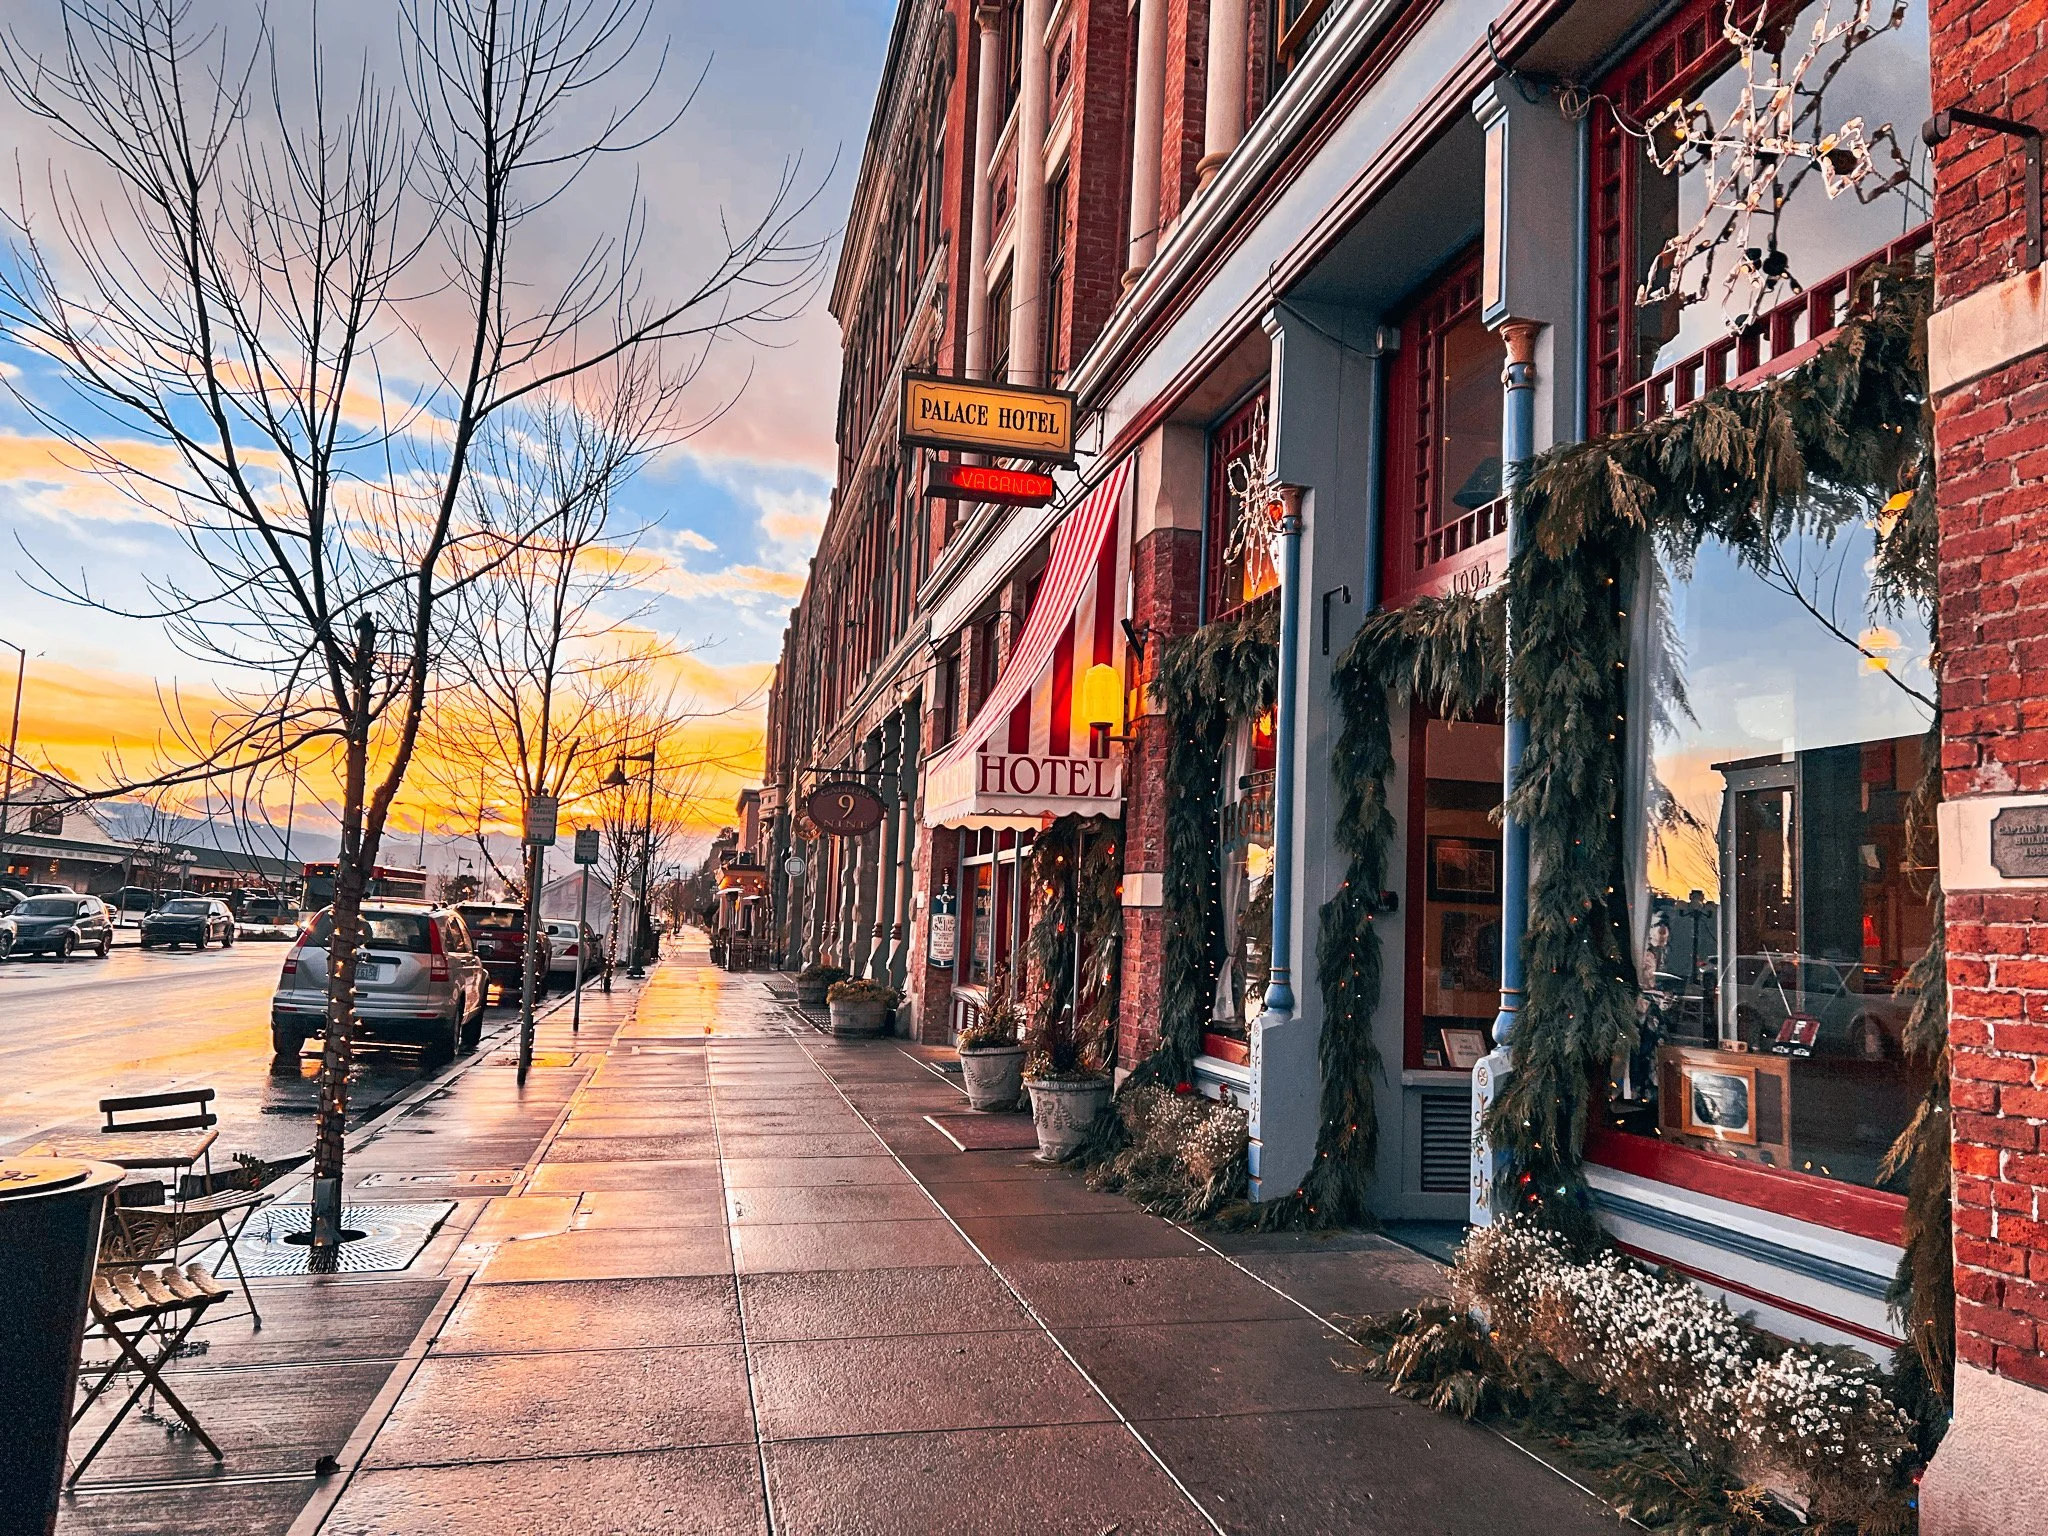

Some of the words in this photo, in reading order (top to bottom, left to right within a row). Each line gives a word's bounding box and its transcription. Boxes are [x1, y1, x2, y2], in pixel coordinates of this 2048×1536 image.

[920, 398, 988, 426] PALACE
[998, 407, 1059, 434] HOTEL
[961, 471, 1047, 495] VACANCY
[1453, 560, 1491, 596] 1004
[980, 755, 1115, 797] HOTEL
[820, 786, 871, 799] GALLERY
[838, 794, 855, 819] 9
[823, 820, 869, 829] NINE
[1999, 824, 2038, 834] CAPTAIN
[932, 921, 955, 932] Seller
[936, 916, 954, 926] Wine
